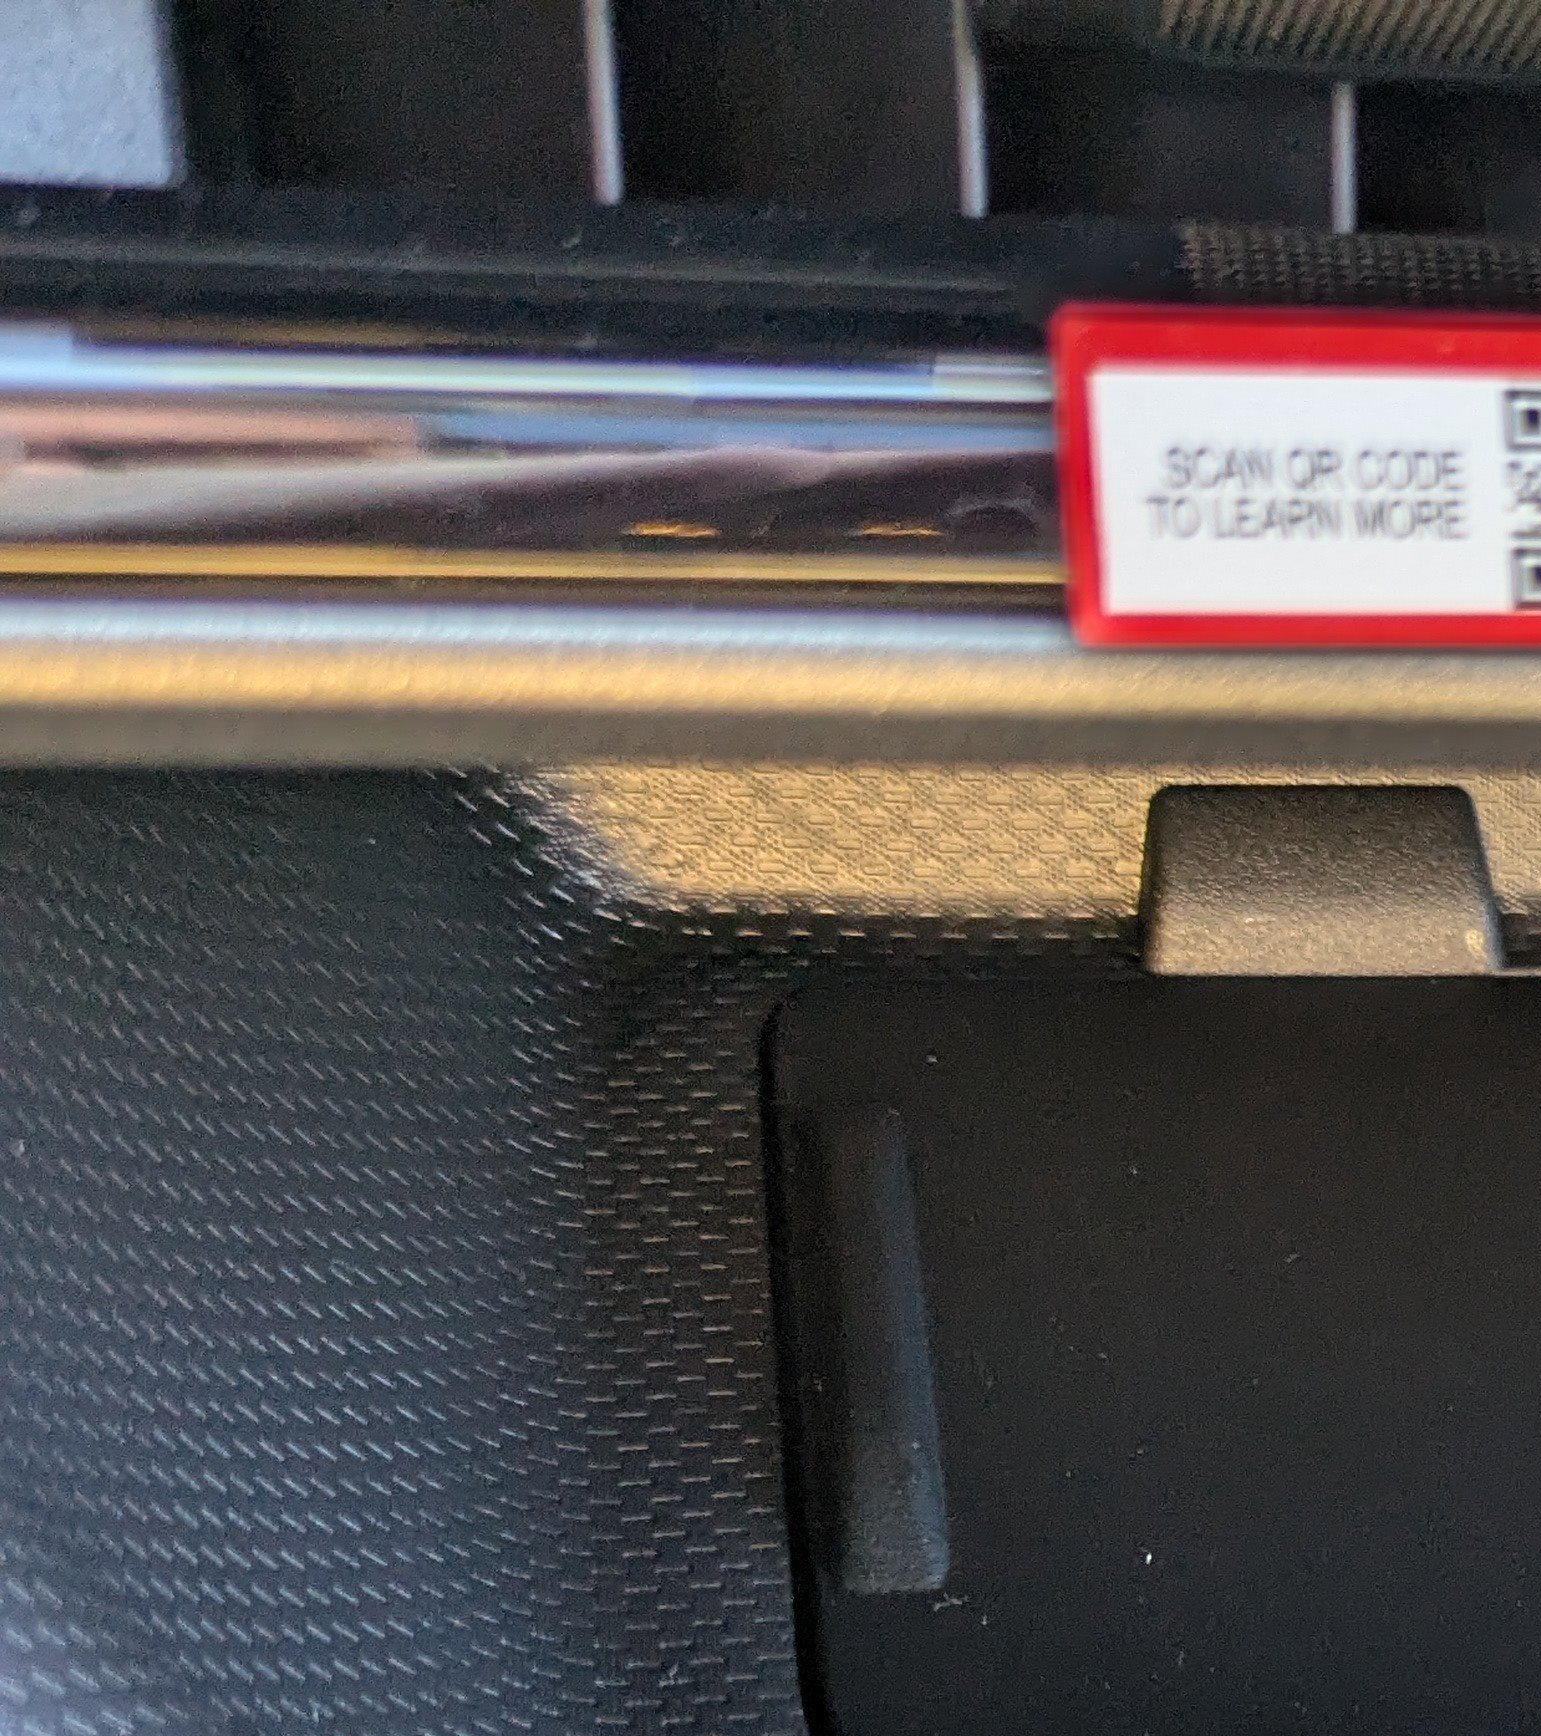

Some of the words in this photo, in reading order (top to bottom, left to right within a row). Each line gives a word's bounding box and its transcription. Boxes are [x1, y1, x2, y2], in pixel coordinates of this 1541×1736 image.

[1164, 443, 1274, 490] SCAN
[1286, 447, 1342, 493] QR
[1356, 448, 1466, 491] CODE
[1146, 496, 1202, 540] TO
[1214, 499, 1342, 541] LEARN
[1354, 500, 1470, 541] MORE
